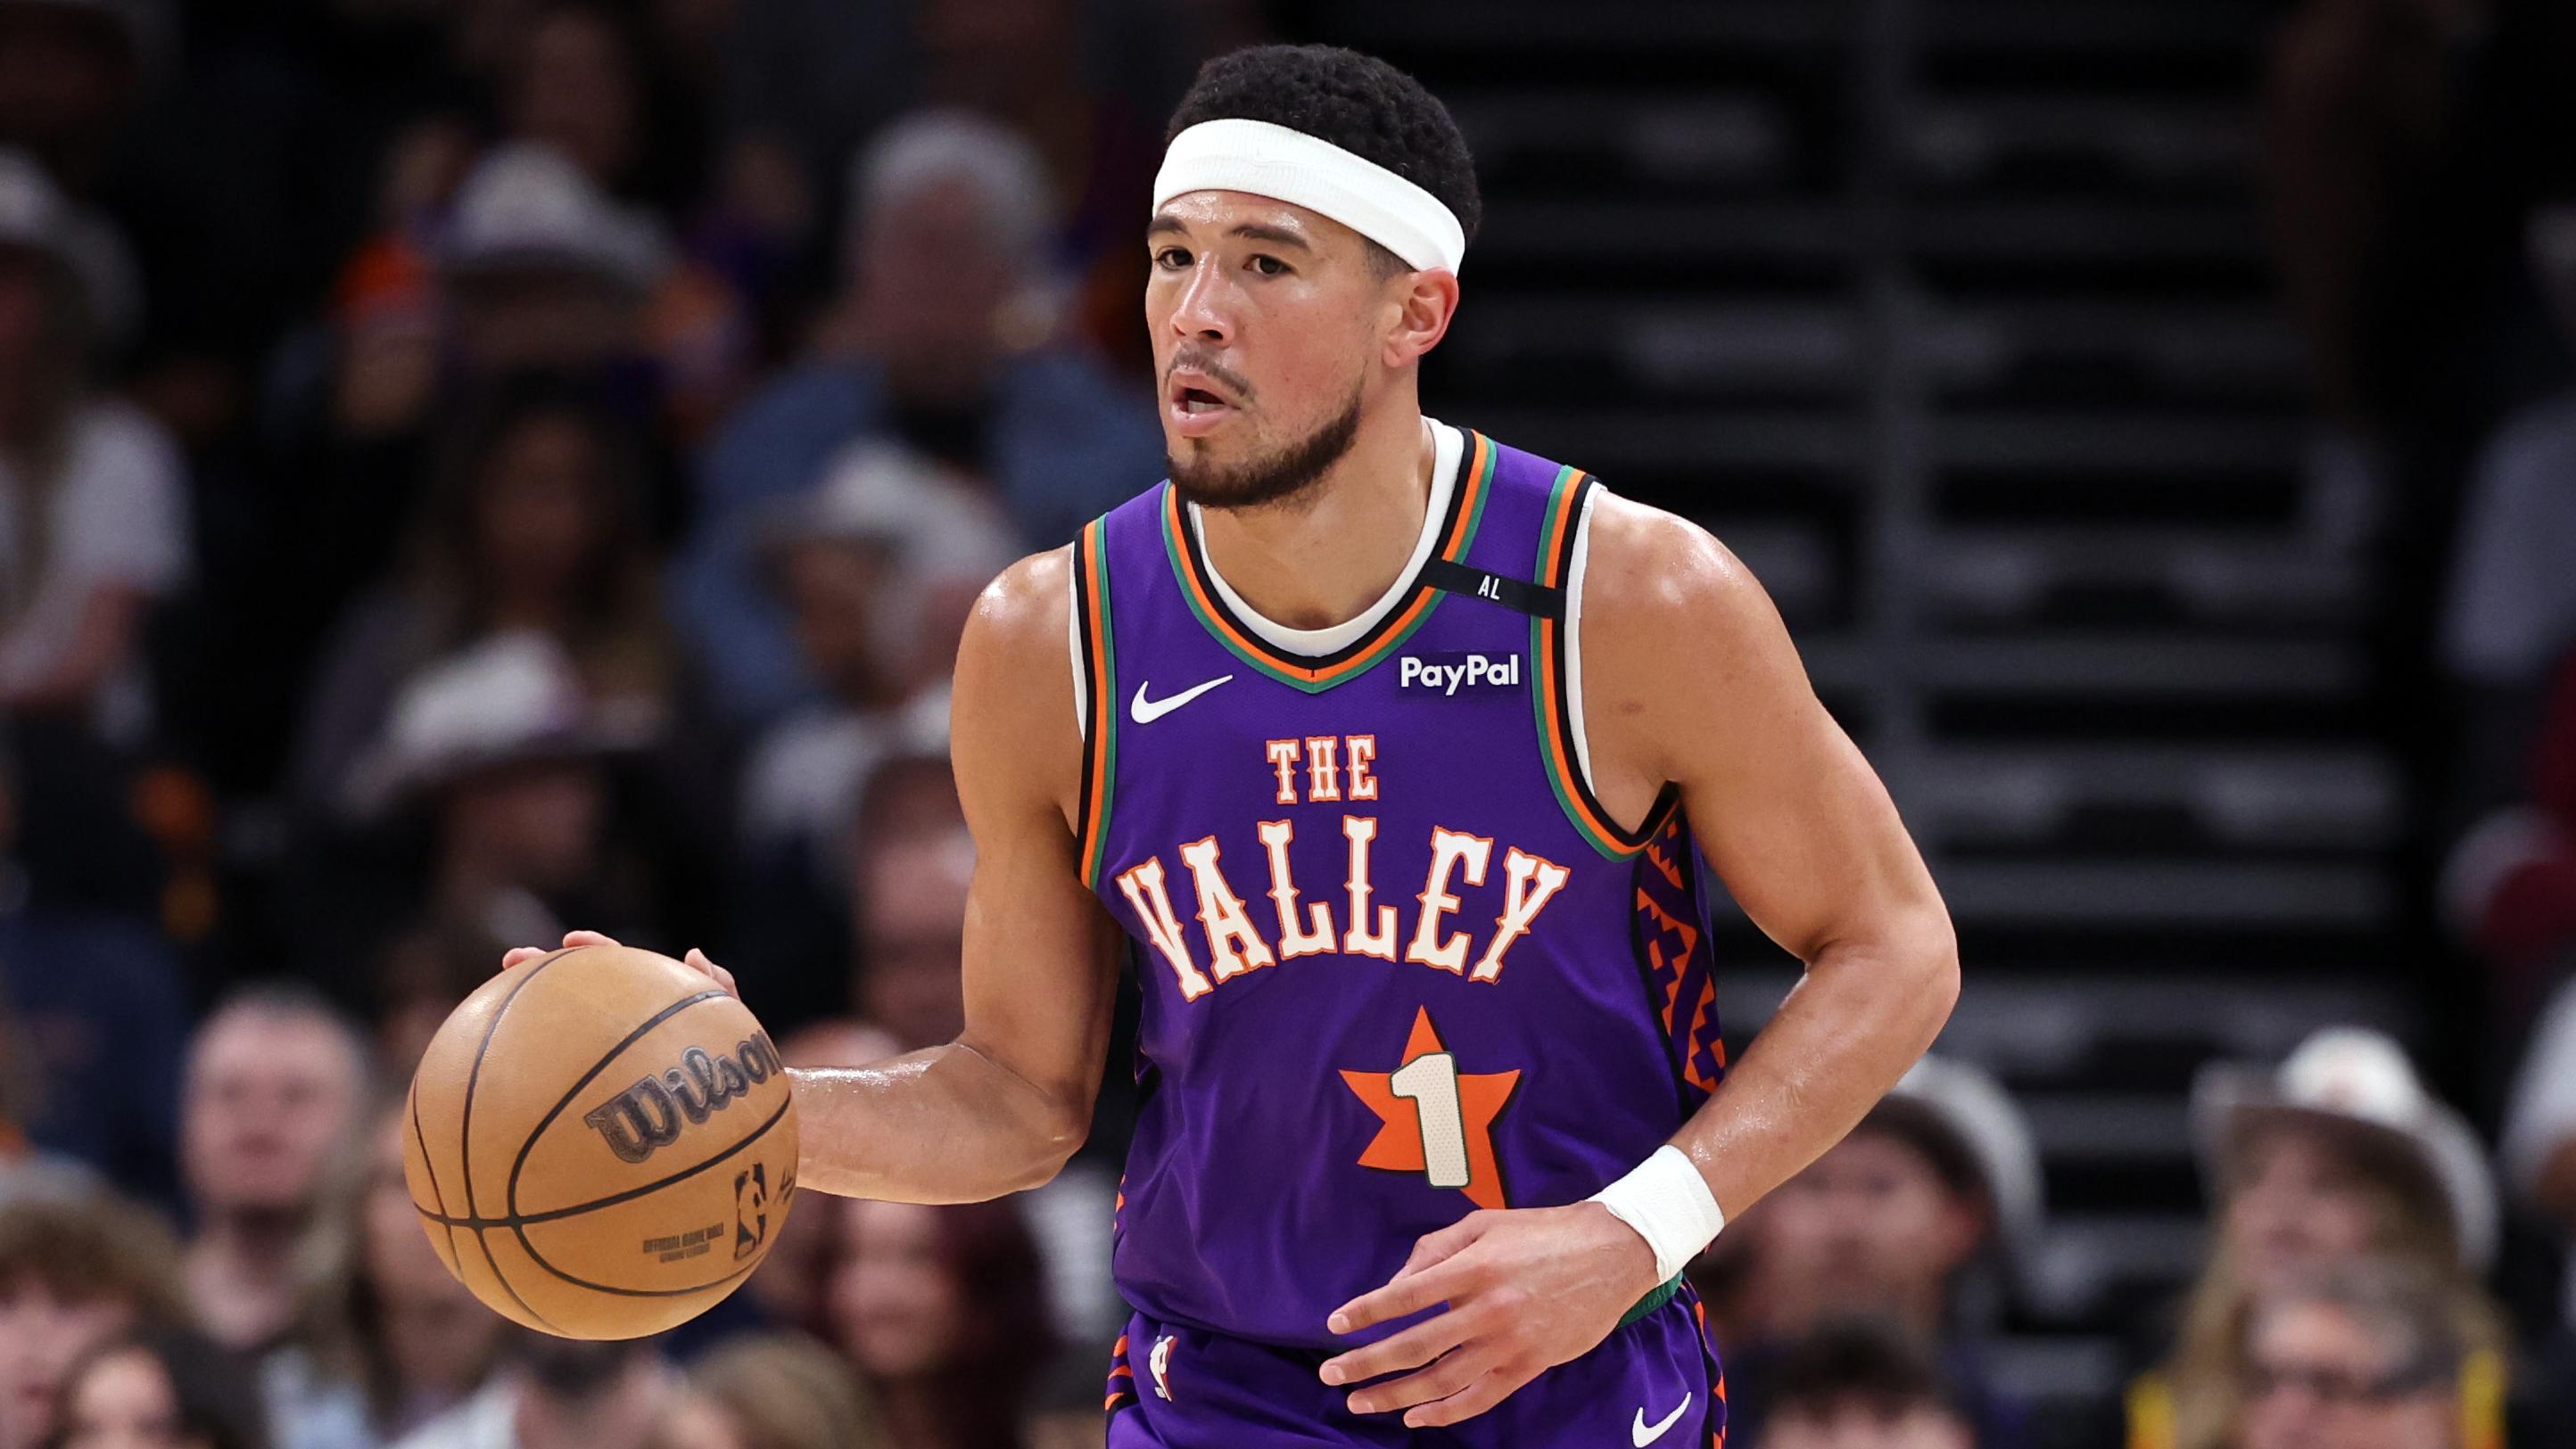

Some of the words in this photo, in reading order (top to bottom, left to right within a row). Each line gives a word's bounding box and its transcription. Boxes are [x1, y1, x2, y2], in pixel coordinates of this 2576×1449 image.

[1477, 575, 1500, 600] AL
[1400, 655, 1519, 696] PayPal
[1267, 734, 1378, 803] THE
[1116, 815, 1571, 1002] VALLEY
[583, 1030, 785, 1163] Wilson
[1390, 1051, 1471, 1189] 1
